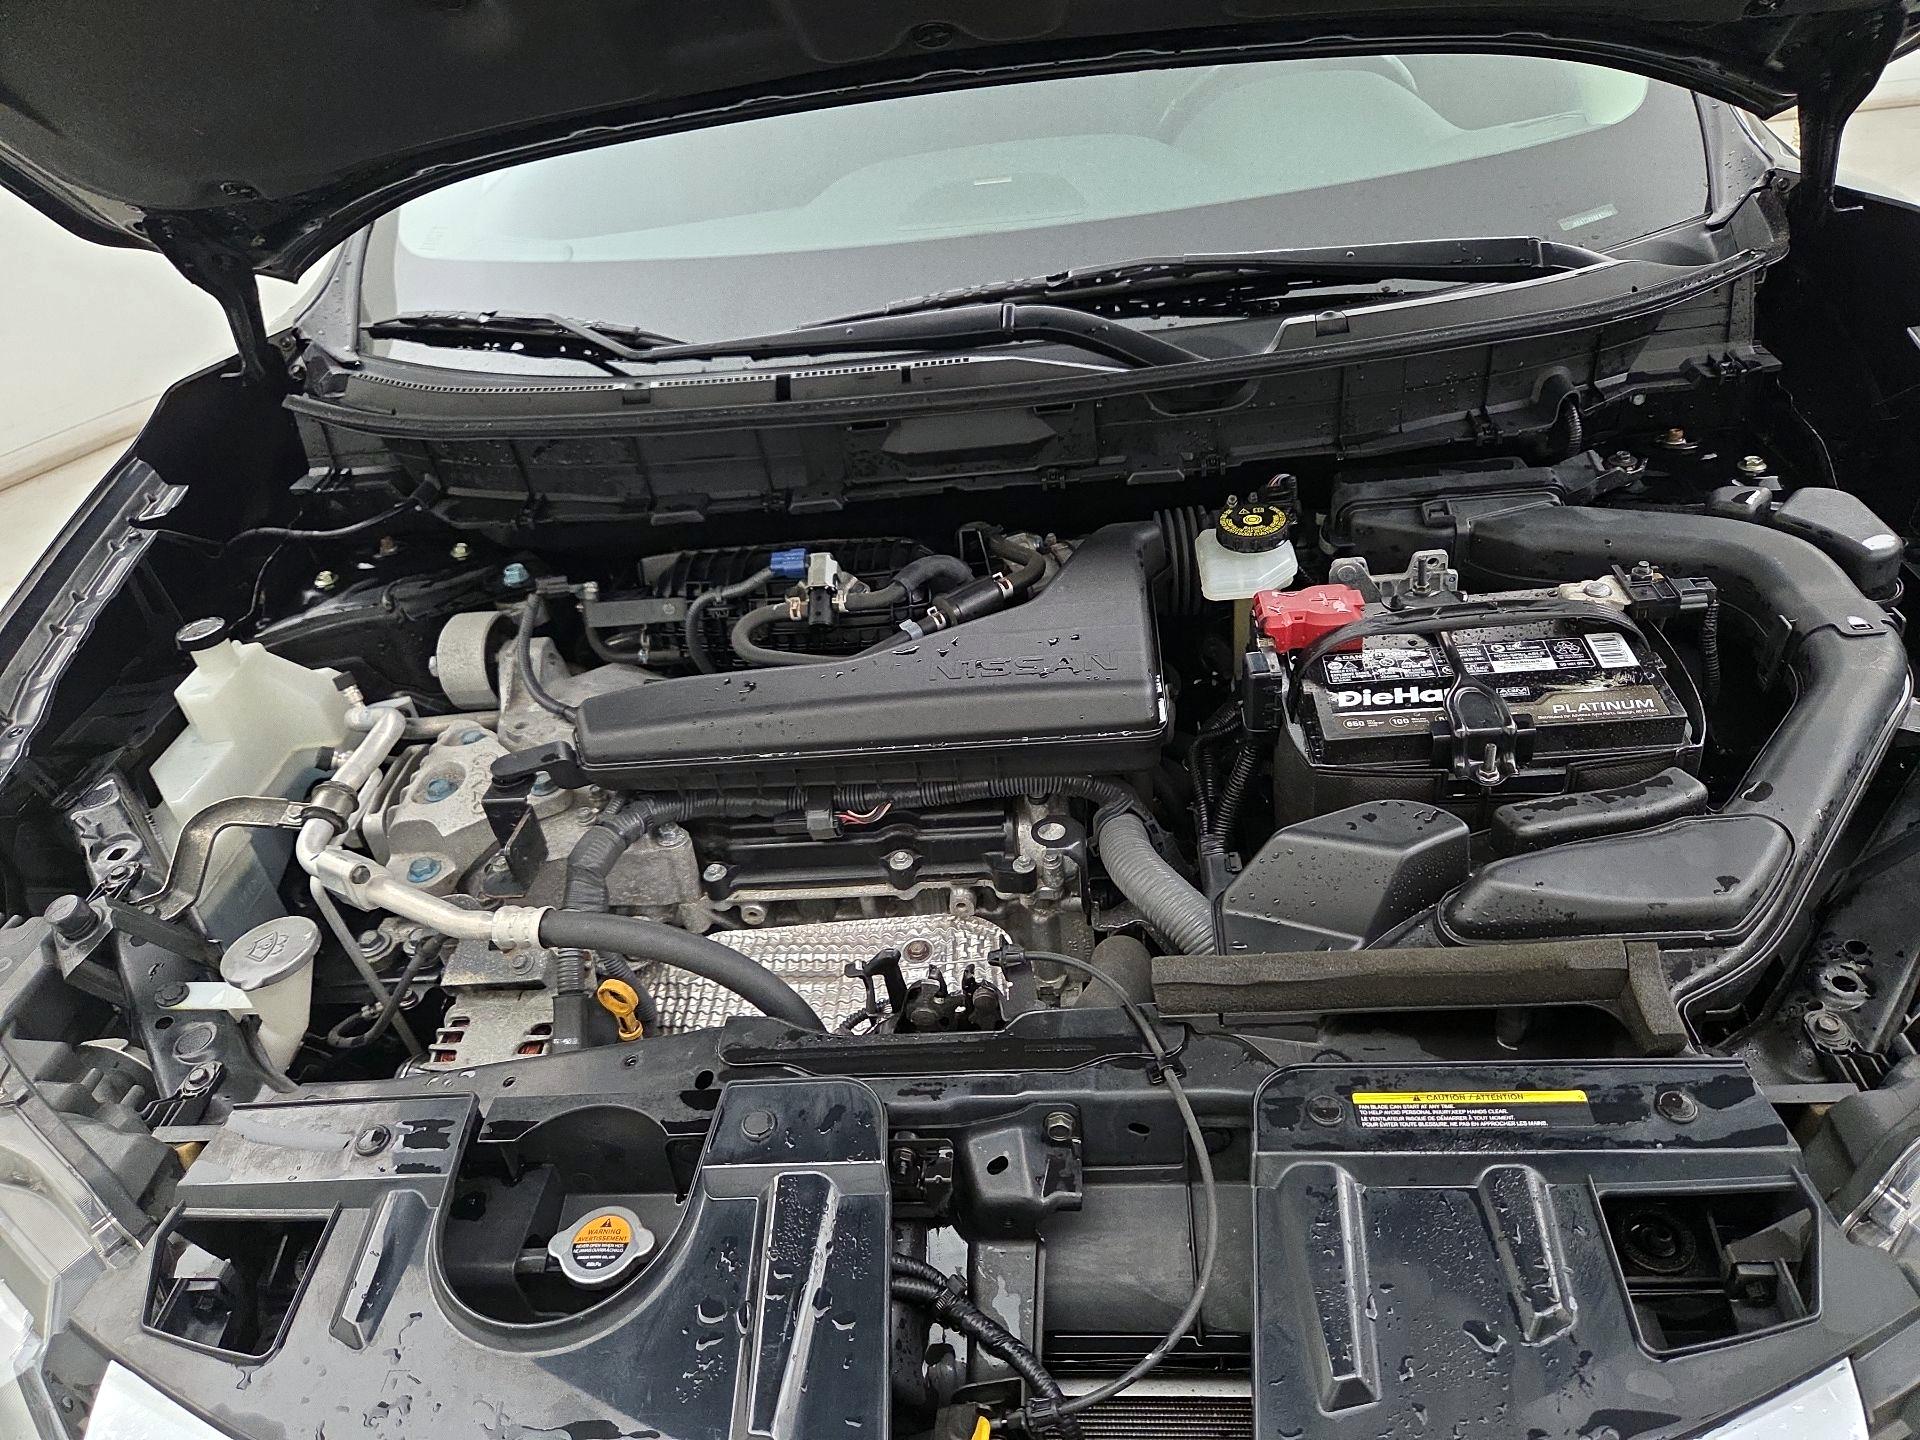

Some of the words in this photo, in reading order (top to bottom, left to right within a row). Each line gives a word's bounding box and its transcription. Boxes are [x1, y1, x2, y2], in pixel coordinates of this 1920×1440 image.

[929, 652, 1119, 681] NISSAN
[1338, 686, 1451, 708] DieHa
[1552, 698, 1655, 714] PLATINUM
[1475, 1093, 1524, 1101] ATTENTION
